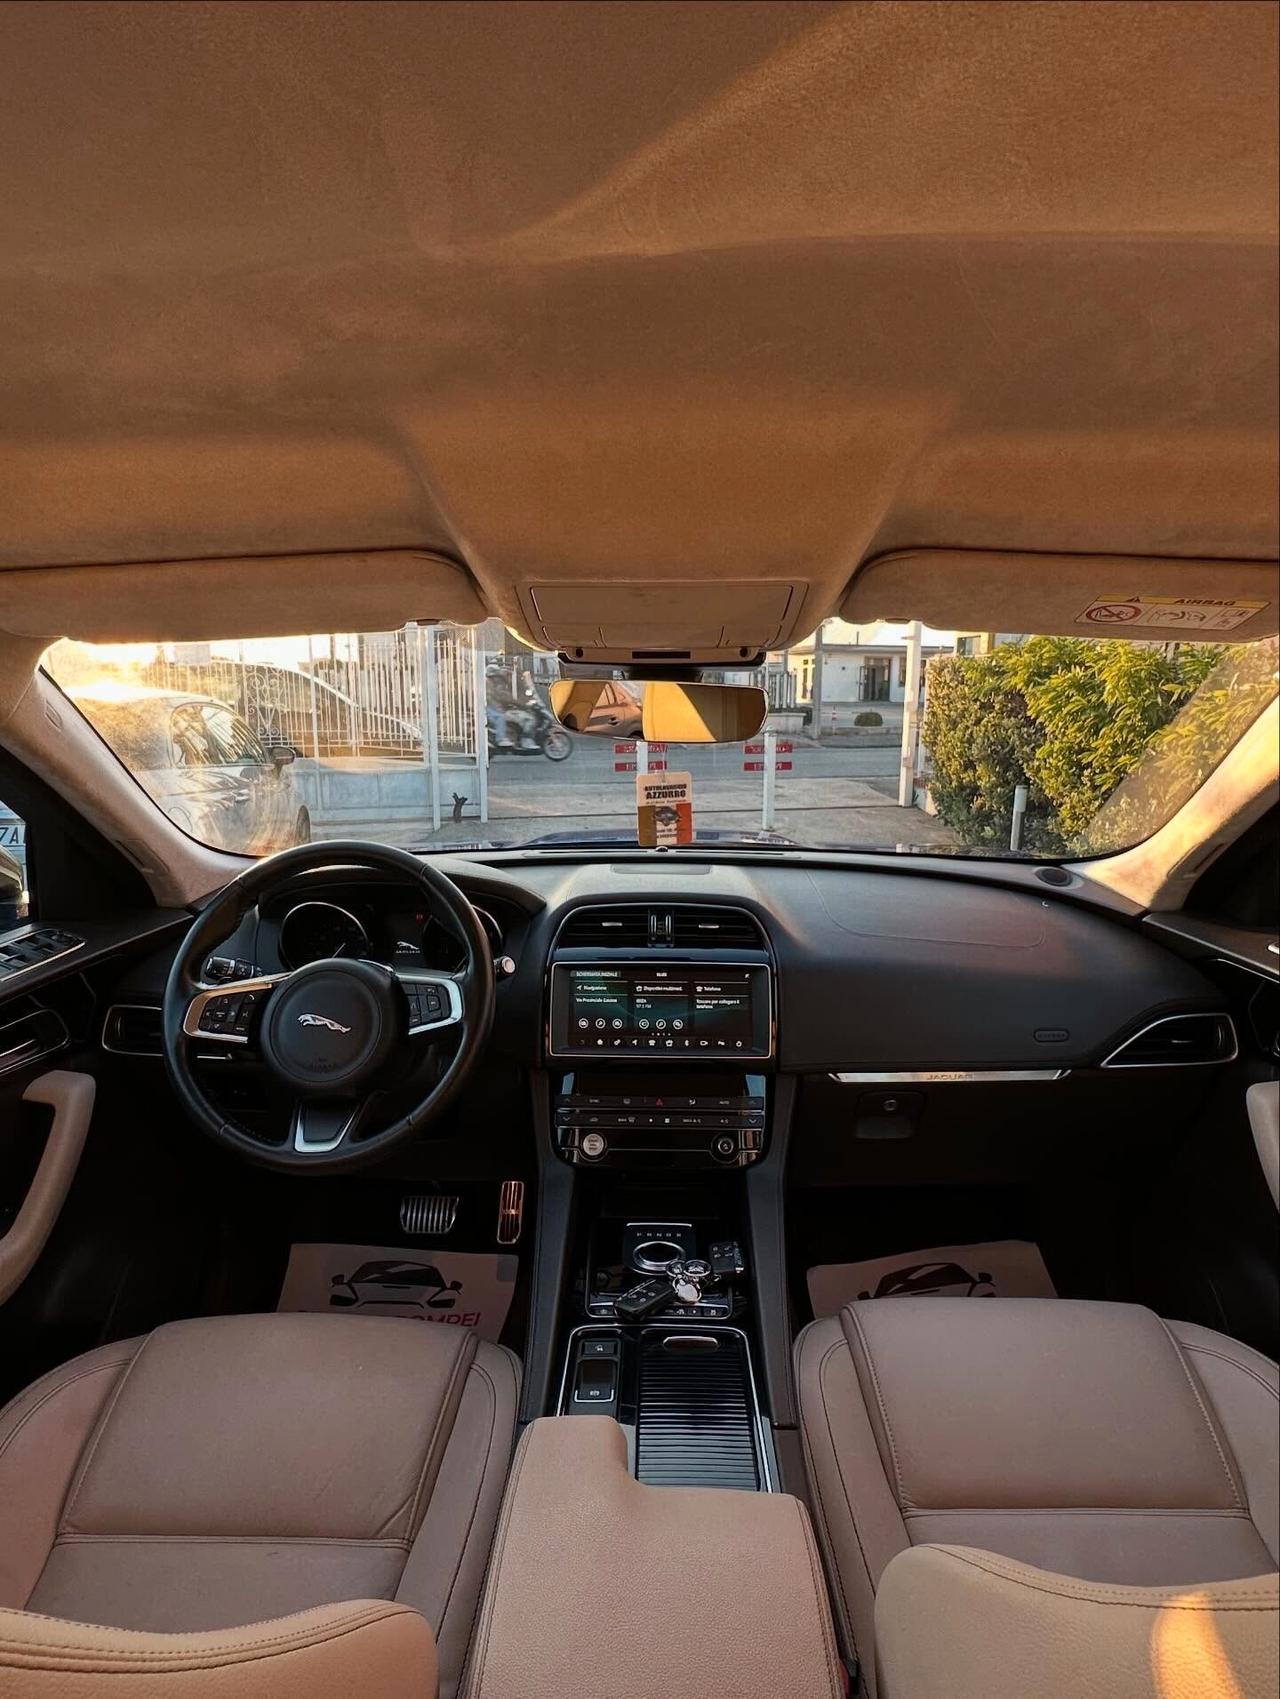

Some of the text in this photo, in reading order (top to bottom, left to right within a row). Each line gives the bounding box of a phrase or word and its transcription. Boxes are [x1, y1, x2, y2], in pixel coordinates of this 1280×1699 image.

[1174, 598, 1236, 606] AIRBAG
[646, 790, 686, 799] AZZURRO
[0, 827, 21, 844] 7A
